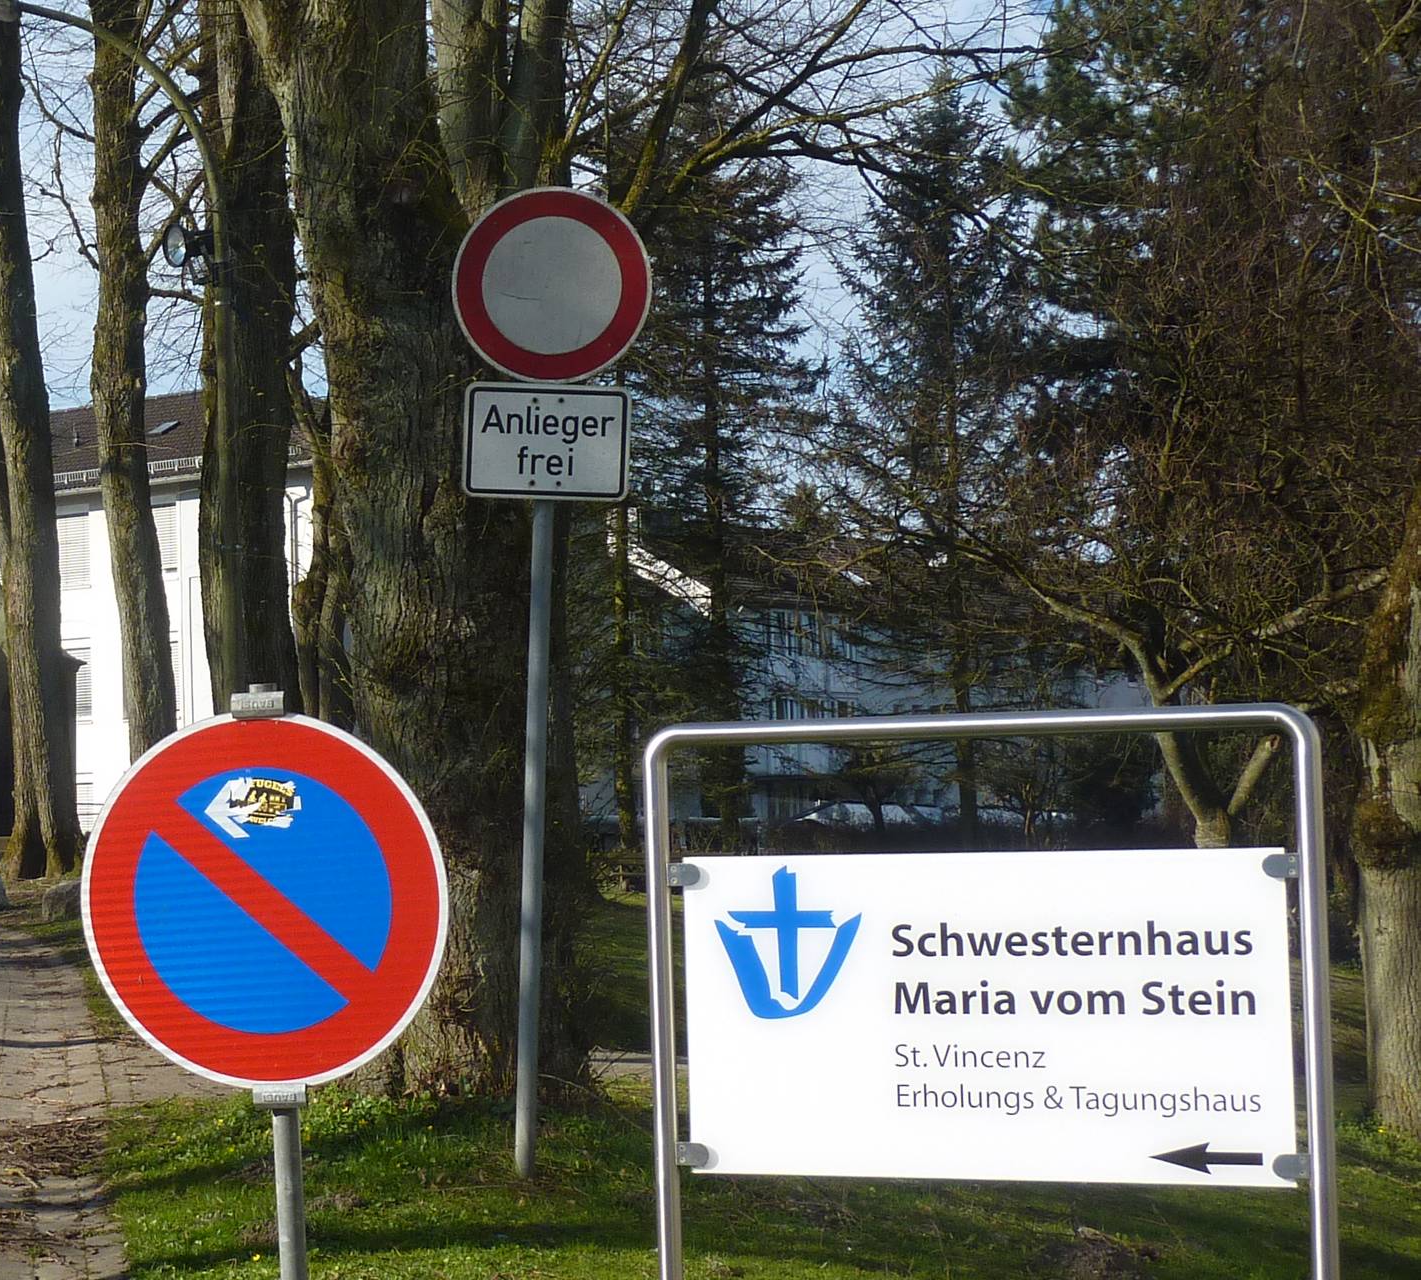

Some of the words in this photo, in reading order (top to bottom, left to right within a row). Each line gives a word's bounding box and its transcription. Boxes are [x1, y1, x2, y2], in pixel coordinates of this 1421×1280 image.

[481, 404, 616, 445] Anlieger
[516, 446, 574, 477] frei
[891, 920, 1253, 958] Schwesternhaus
[894, 979, 1016, 1015] Maria
[1030, 990, 1126, 1016] vom
[1141, 979, 1257, 1016] Stein
[894, 1043, 928, 1068] St.
[932, 1044, 1047, 1069] Vincenz
[896, 1083, 1035, 1116] Erholungs
[1043, 1085, 1064, 1110] &
[1068, 1085, 1262, 1118] Tagungshaus
